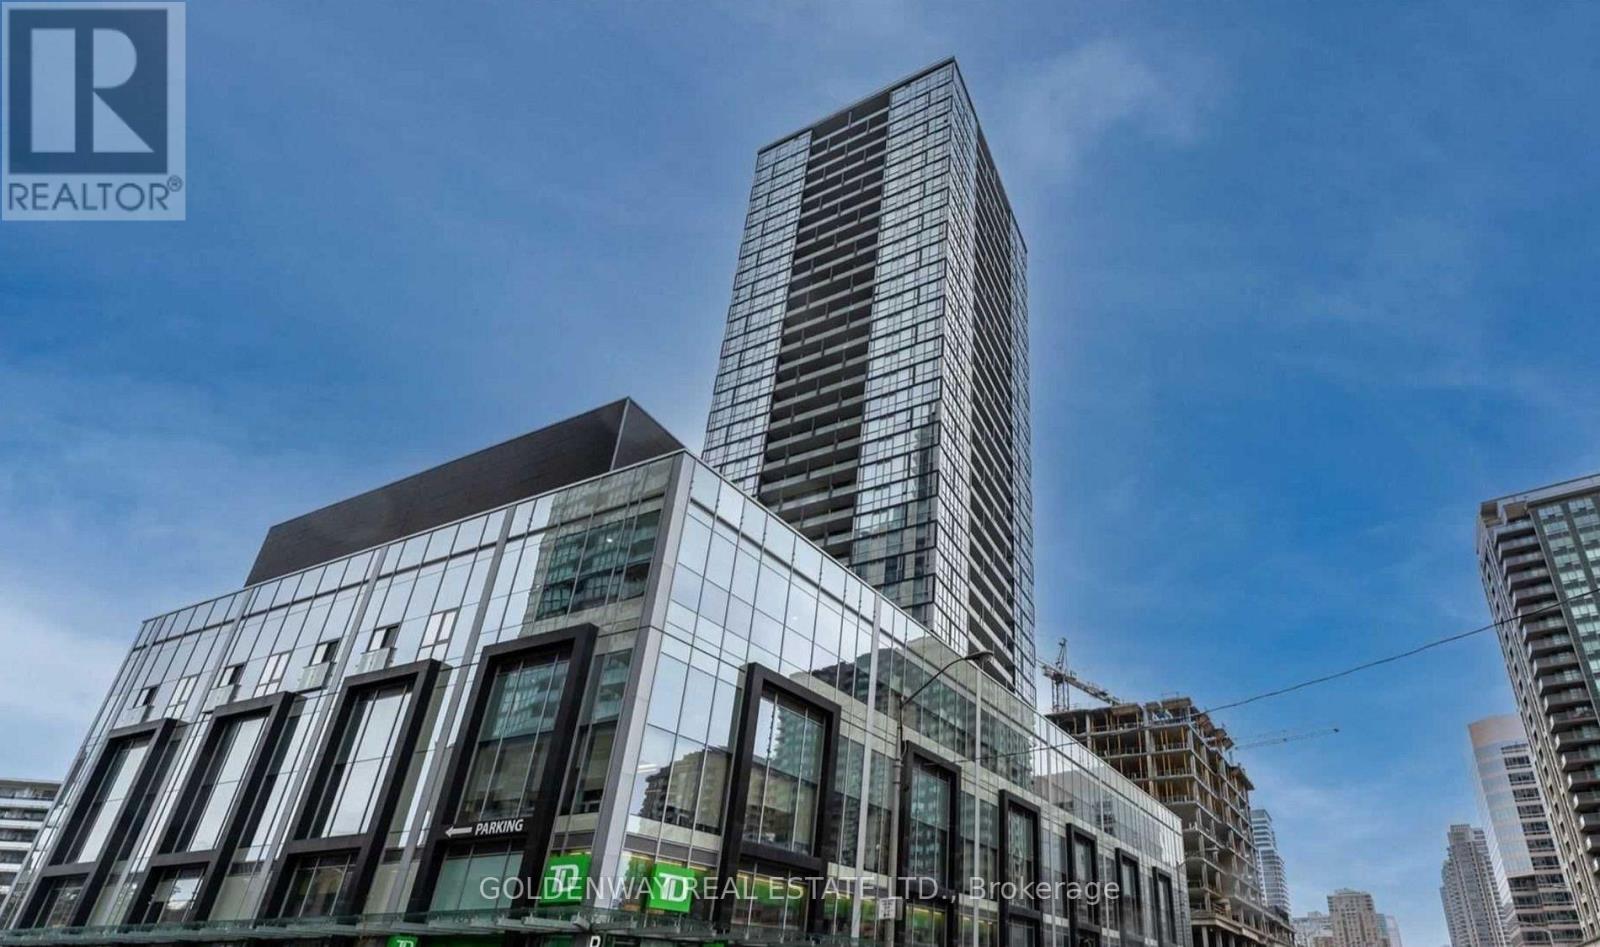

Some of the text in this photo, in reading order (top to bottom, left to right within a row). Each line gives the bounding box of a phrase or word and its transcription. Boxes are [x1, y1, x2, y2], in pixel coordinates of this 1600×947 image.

[474, 819, 524, 836] PARKING
[550, 864, 580, 893] TD
[658, 873, 689, 902] TD
